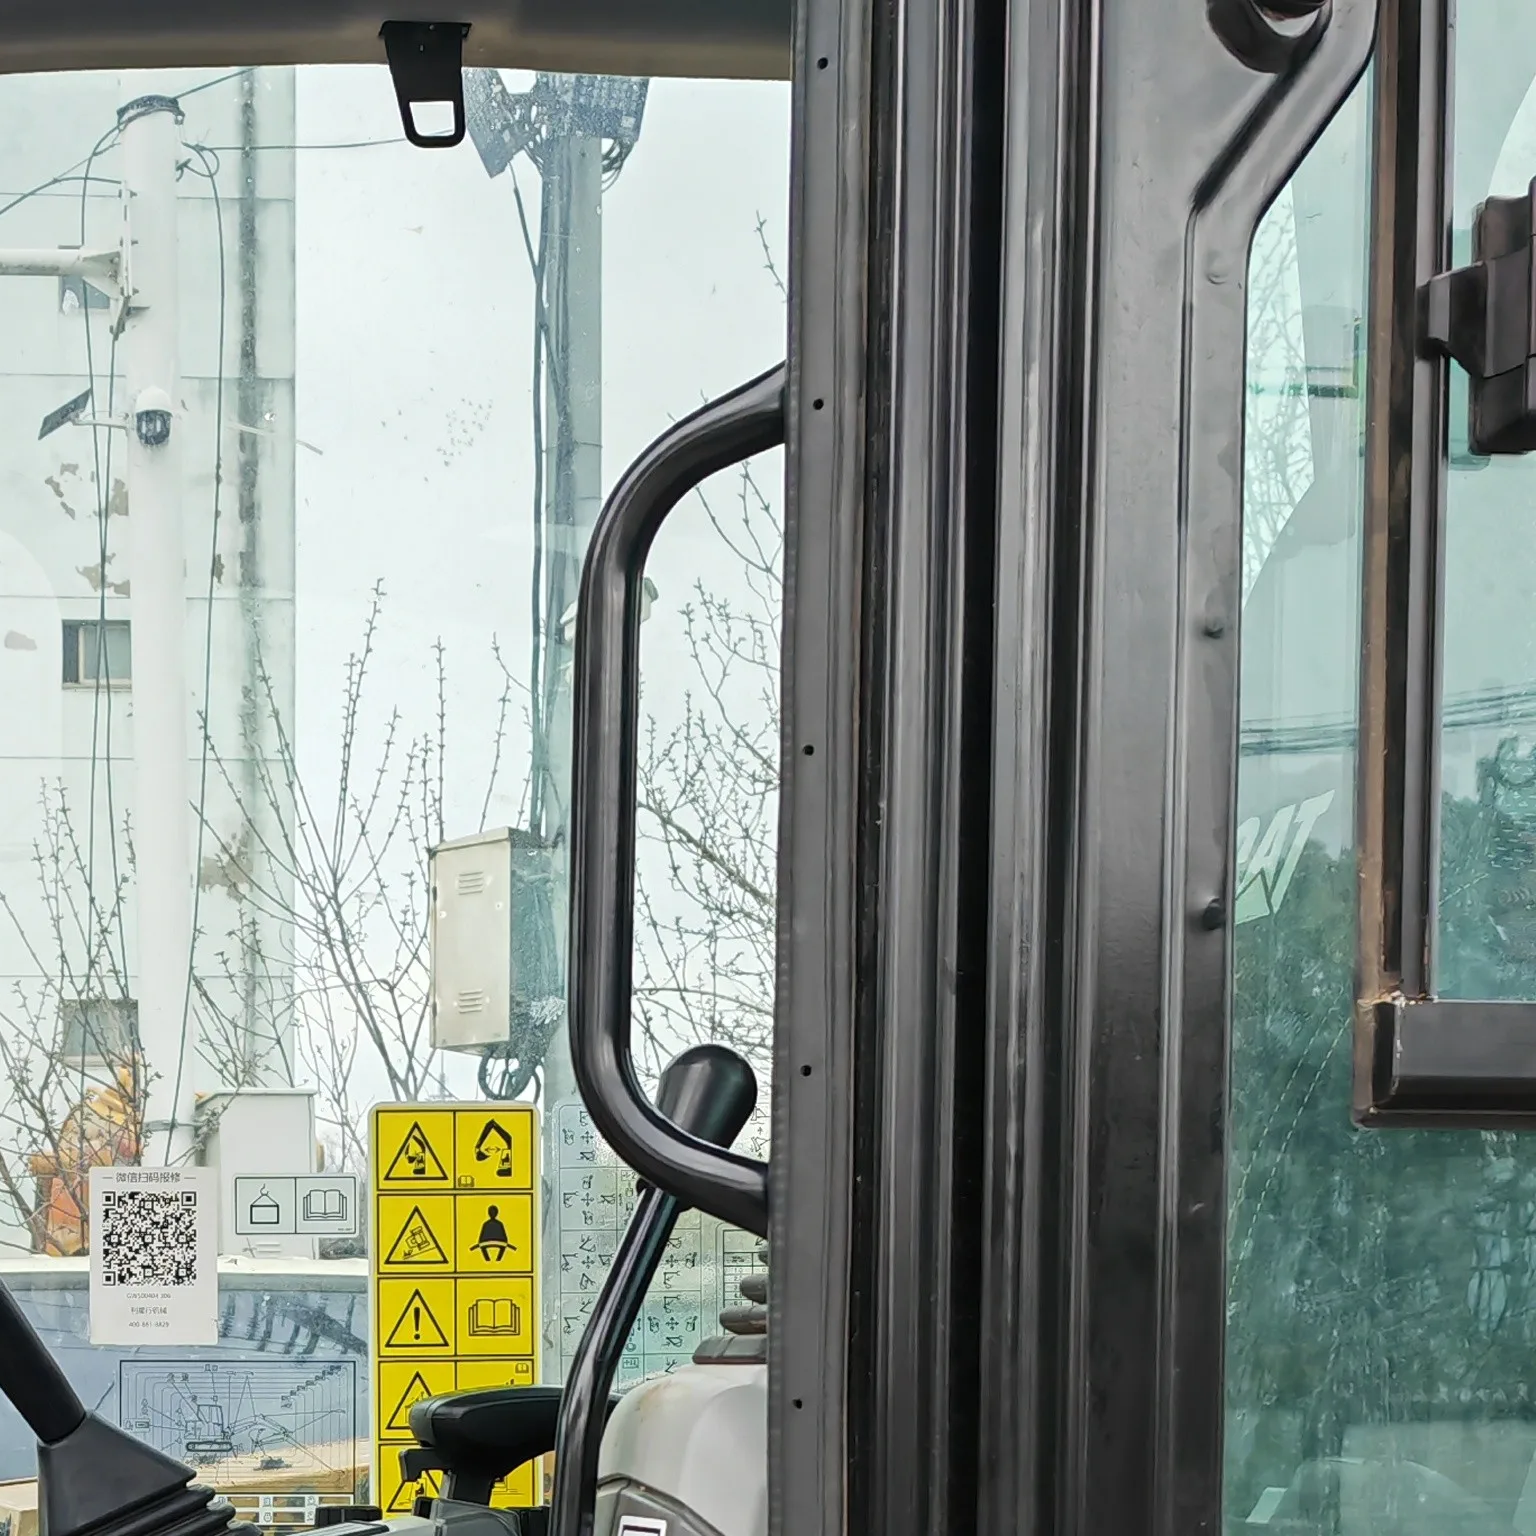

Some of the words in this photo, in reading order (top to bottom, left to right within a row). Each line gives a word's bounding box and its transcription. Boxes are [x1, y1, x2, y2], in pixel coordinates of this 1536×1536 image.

[115, 1172, 181, 1183] 微信扫码报修
